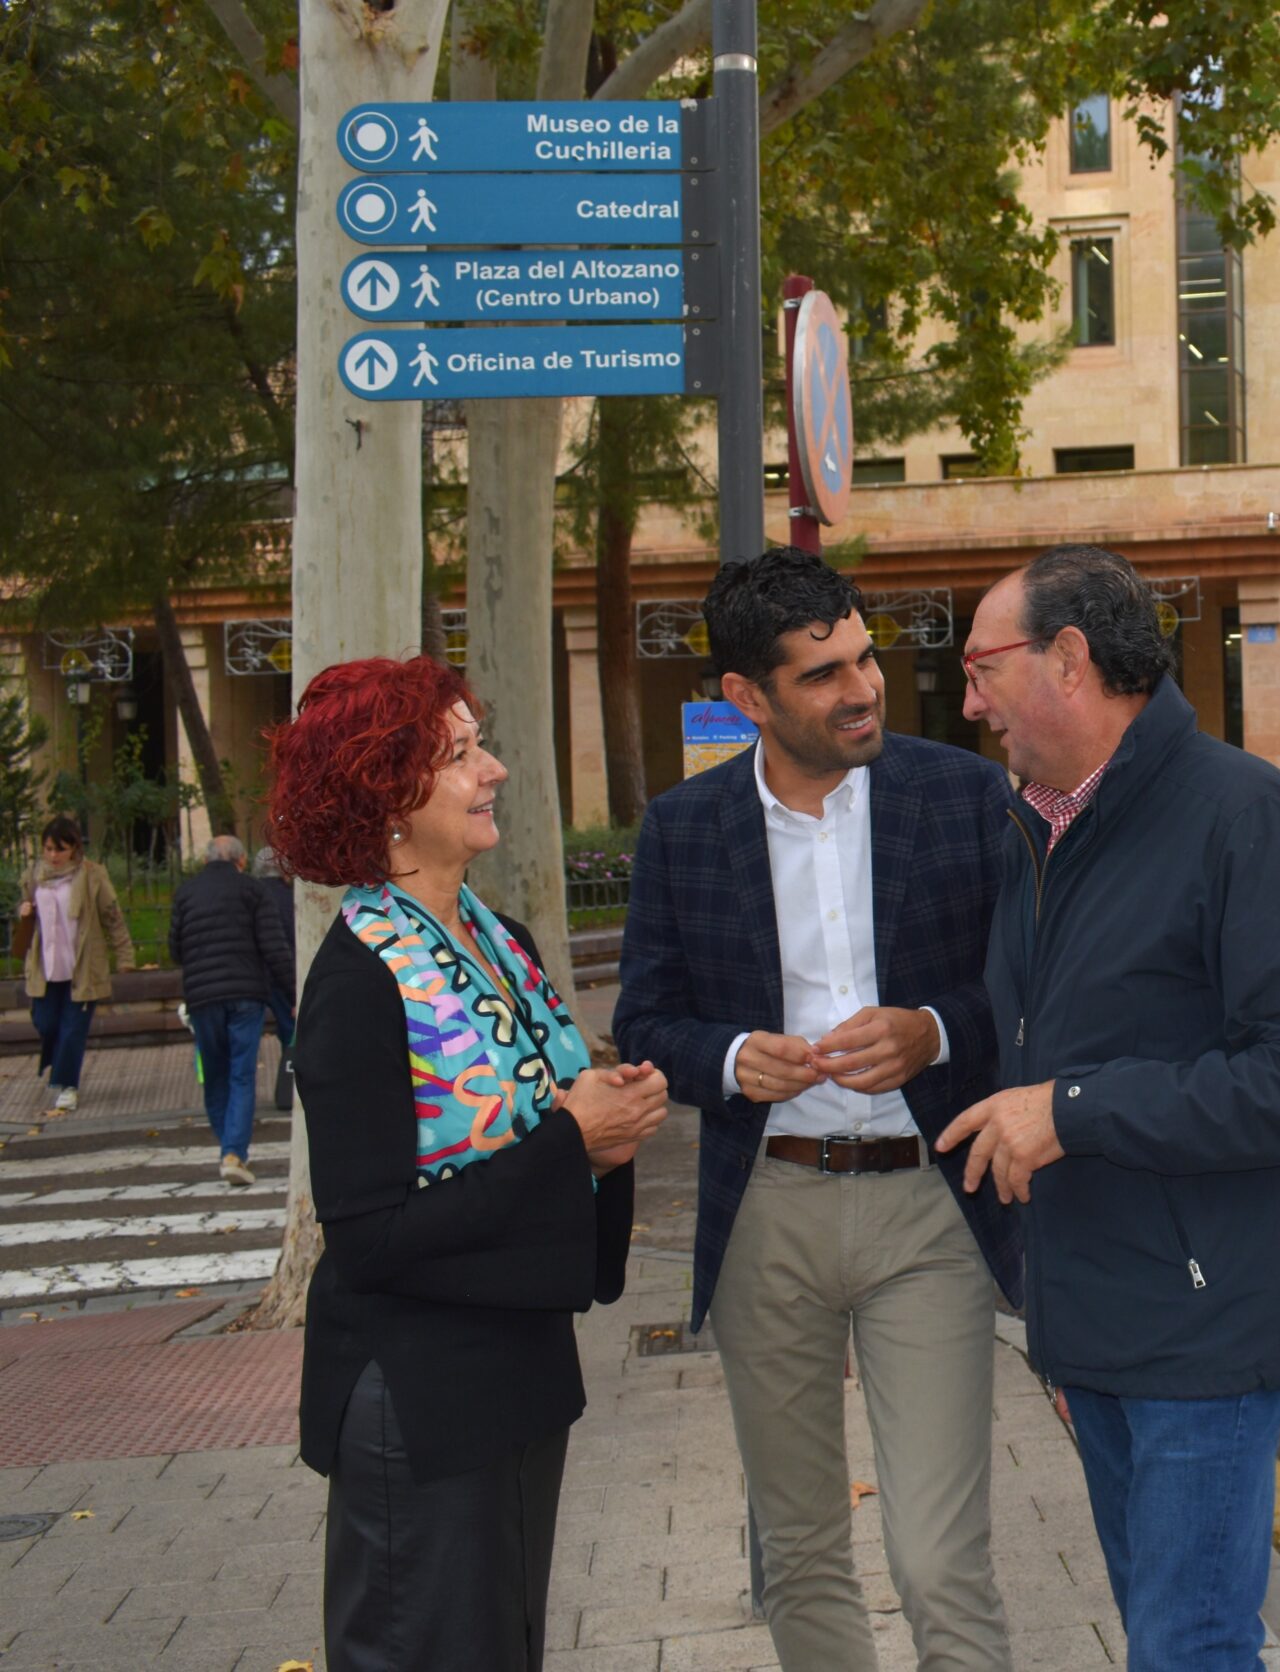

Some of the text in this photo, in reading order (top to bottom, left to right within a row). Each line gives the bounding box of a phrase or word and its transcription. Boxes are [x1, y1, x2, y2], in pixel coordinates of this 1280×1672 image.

[527, 114, 679, 133] Museo de la
[576, 200, 679, 218] Catedral
[455, 260, 680, 280] Plaza del Altozano
[476, 287, 660, 310] (Centro Urbano)
[447, 349, 681, 372] Oficina de Turismo
